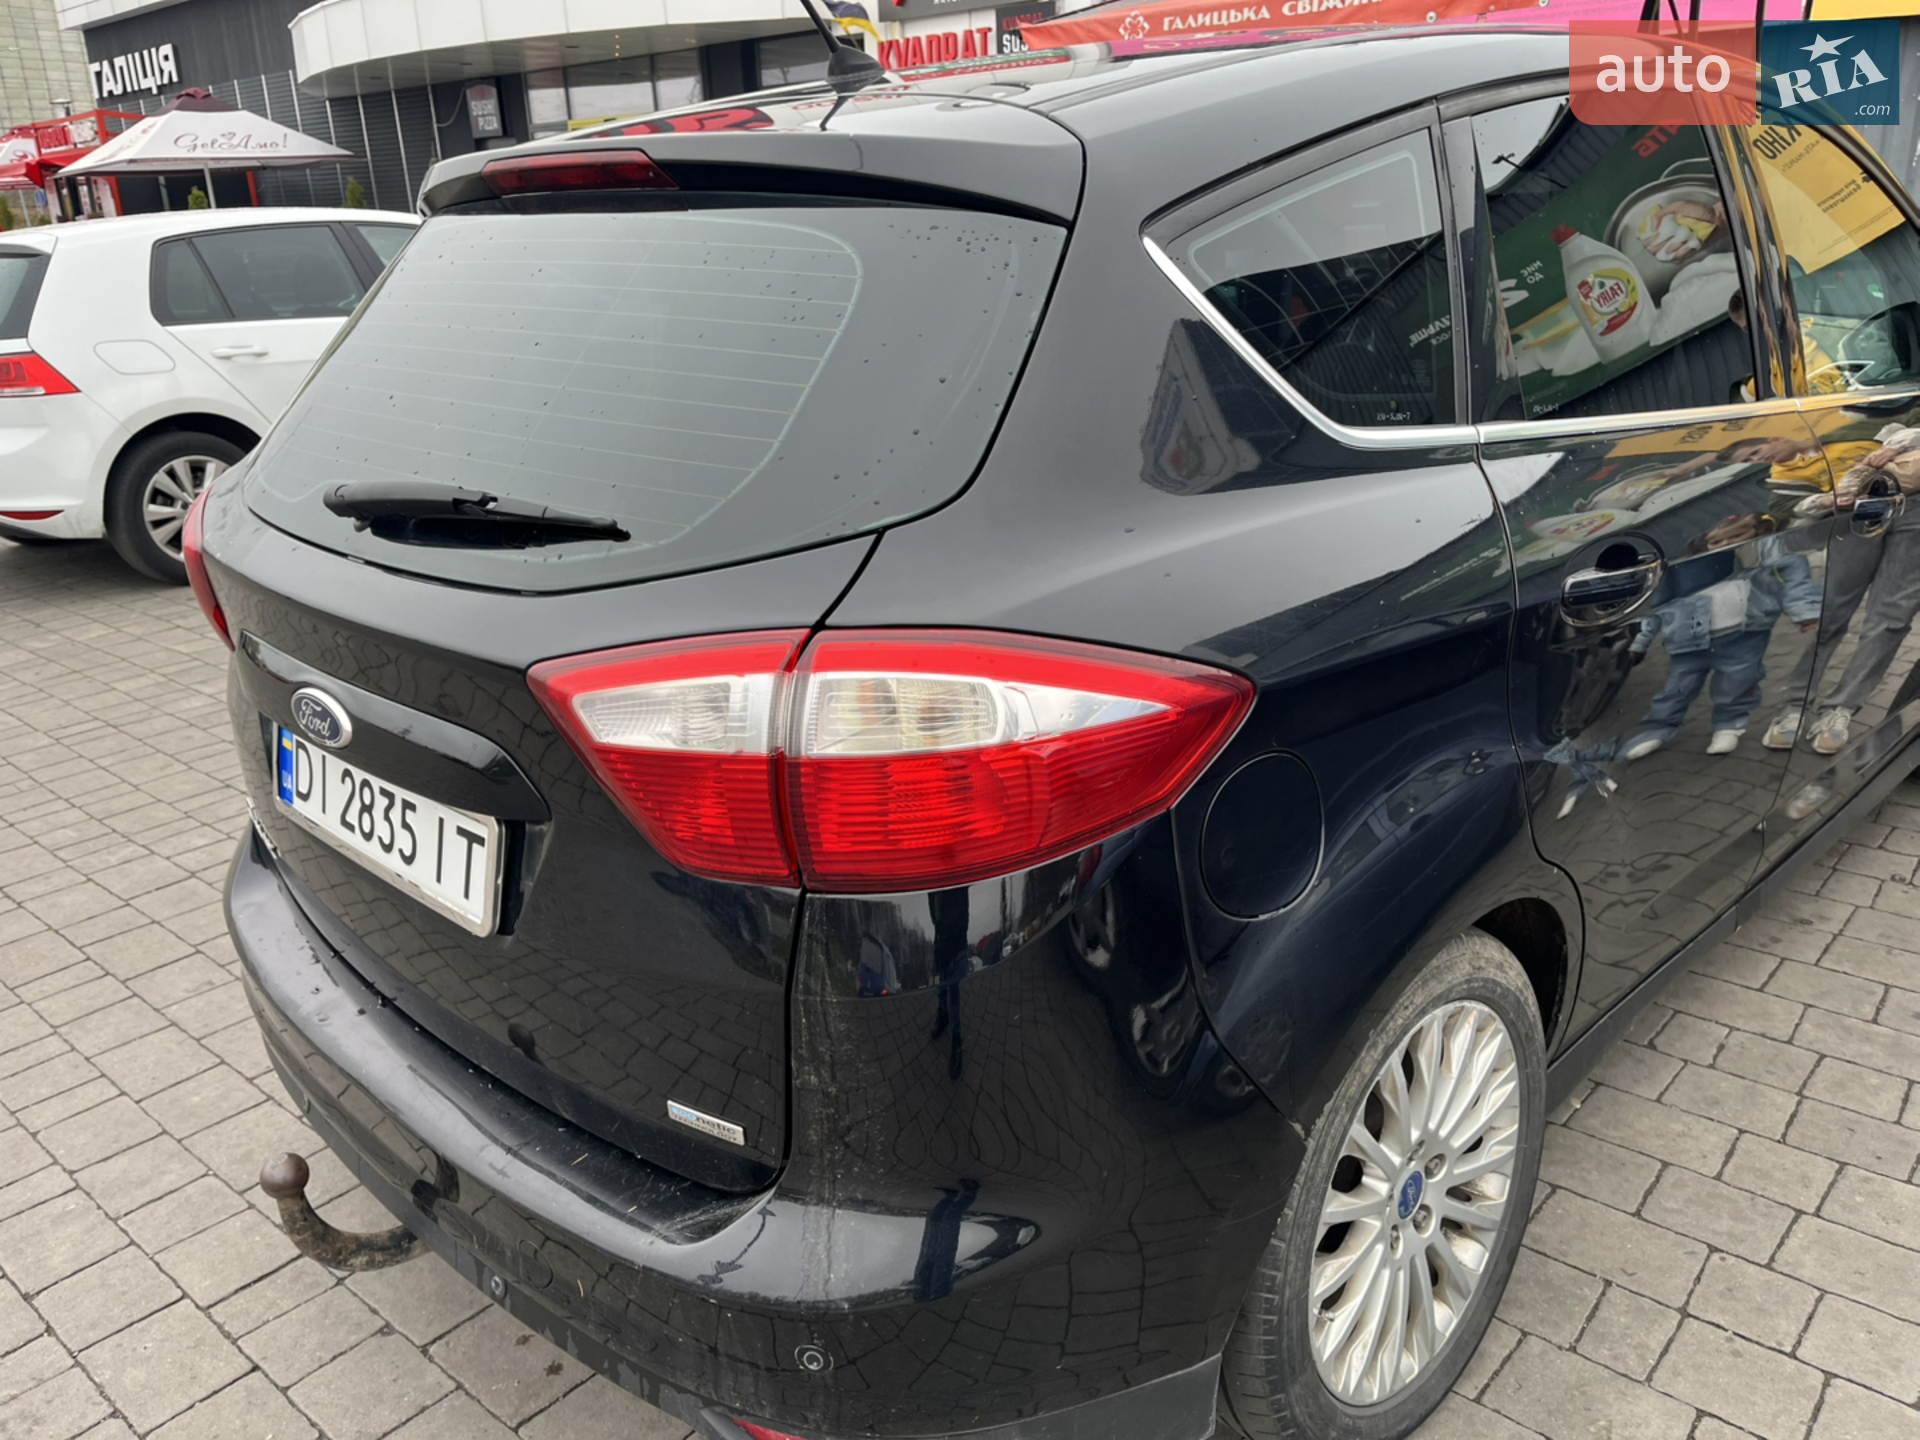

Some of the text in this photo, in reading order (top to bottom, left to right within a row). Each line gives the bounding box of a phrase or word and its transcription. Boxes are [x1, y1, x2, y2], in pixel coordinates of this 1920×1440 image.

[1163, 5, 1270, 31] ГАЛИЦЬКА
[878, 27, 992, 70] KVADRAT
[299, 698, 331, 737] Ford
[282, 769, 292, 790] UA
[296, 738, 326, 815] DI
[340, 768, 417, 866] 2835
[436, 816, 485, 901] IT
